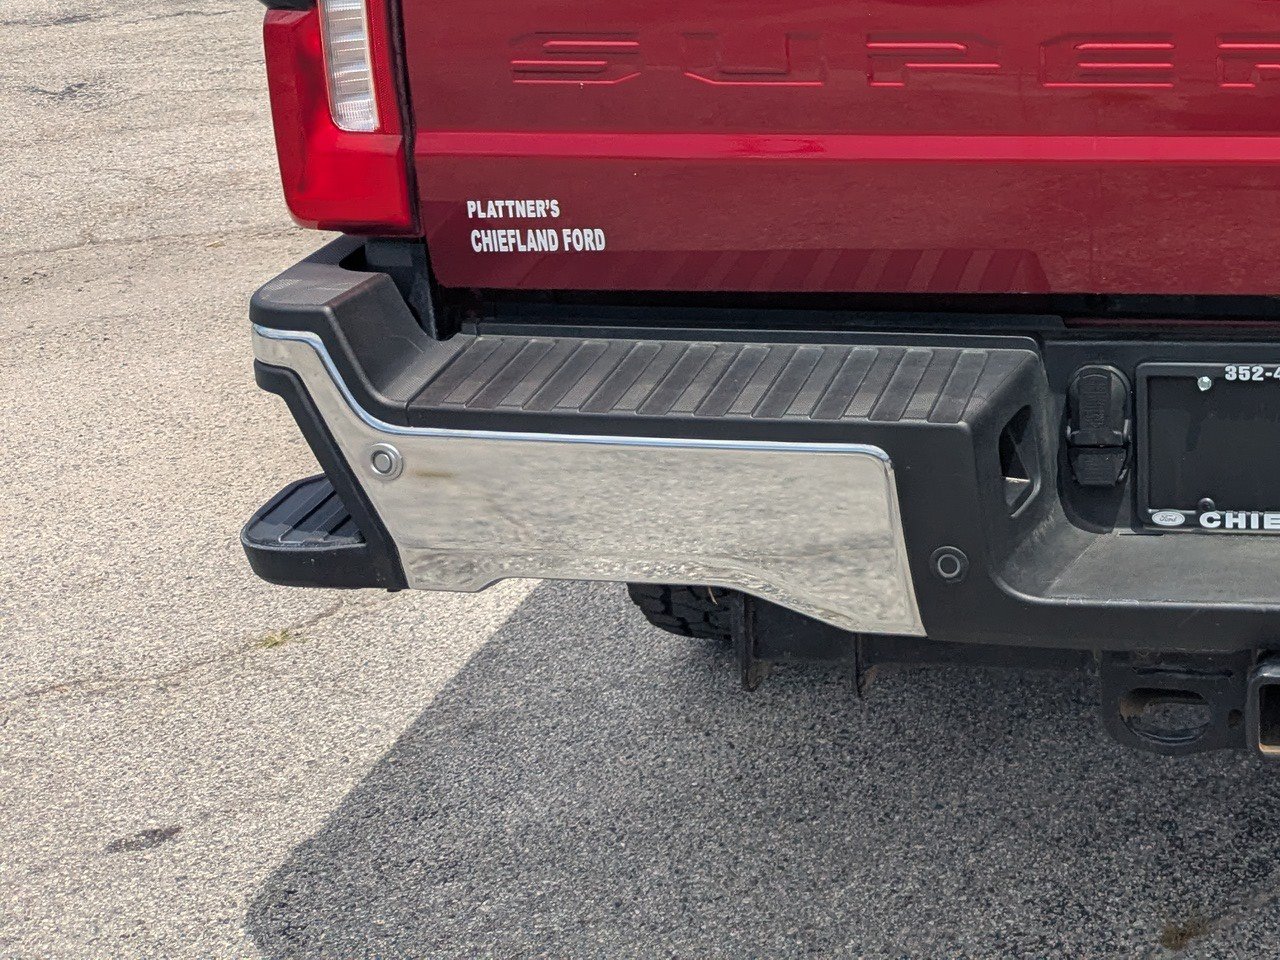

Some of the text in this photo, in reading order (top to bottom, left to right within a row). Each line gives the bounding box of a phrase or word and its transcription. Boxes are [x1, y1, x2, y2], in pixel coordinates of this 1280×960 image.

[466, 199, 561, 219] PLATTNER'S
[470, 228, 606, 252] CHIEFLAND FORD
